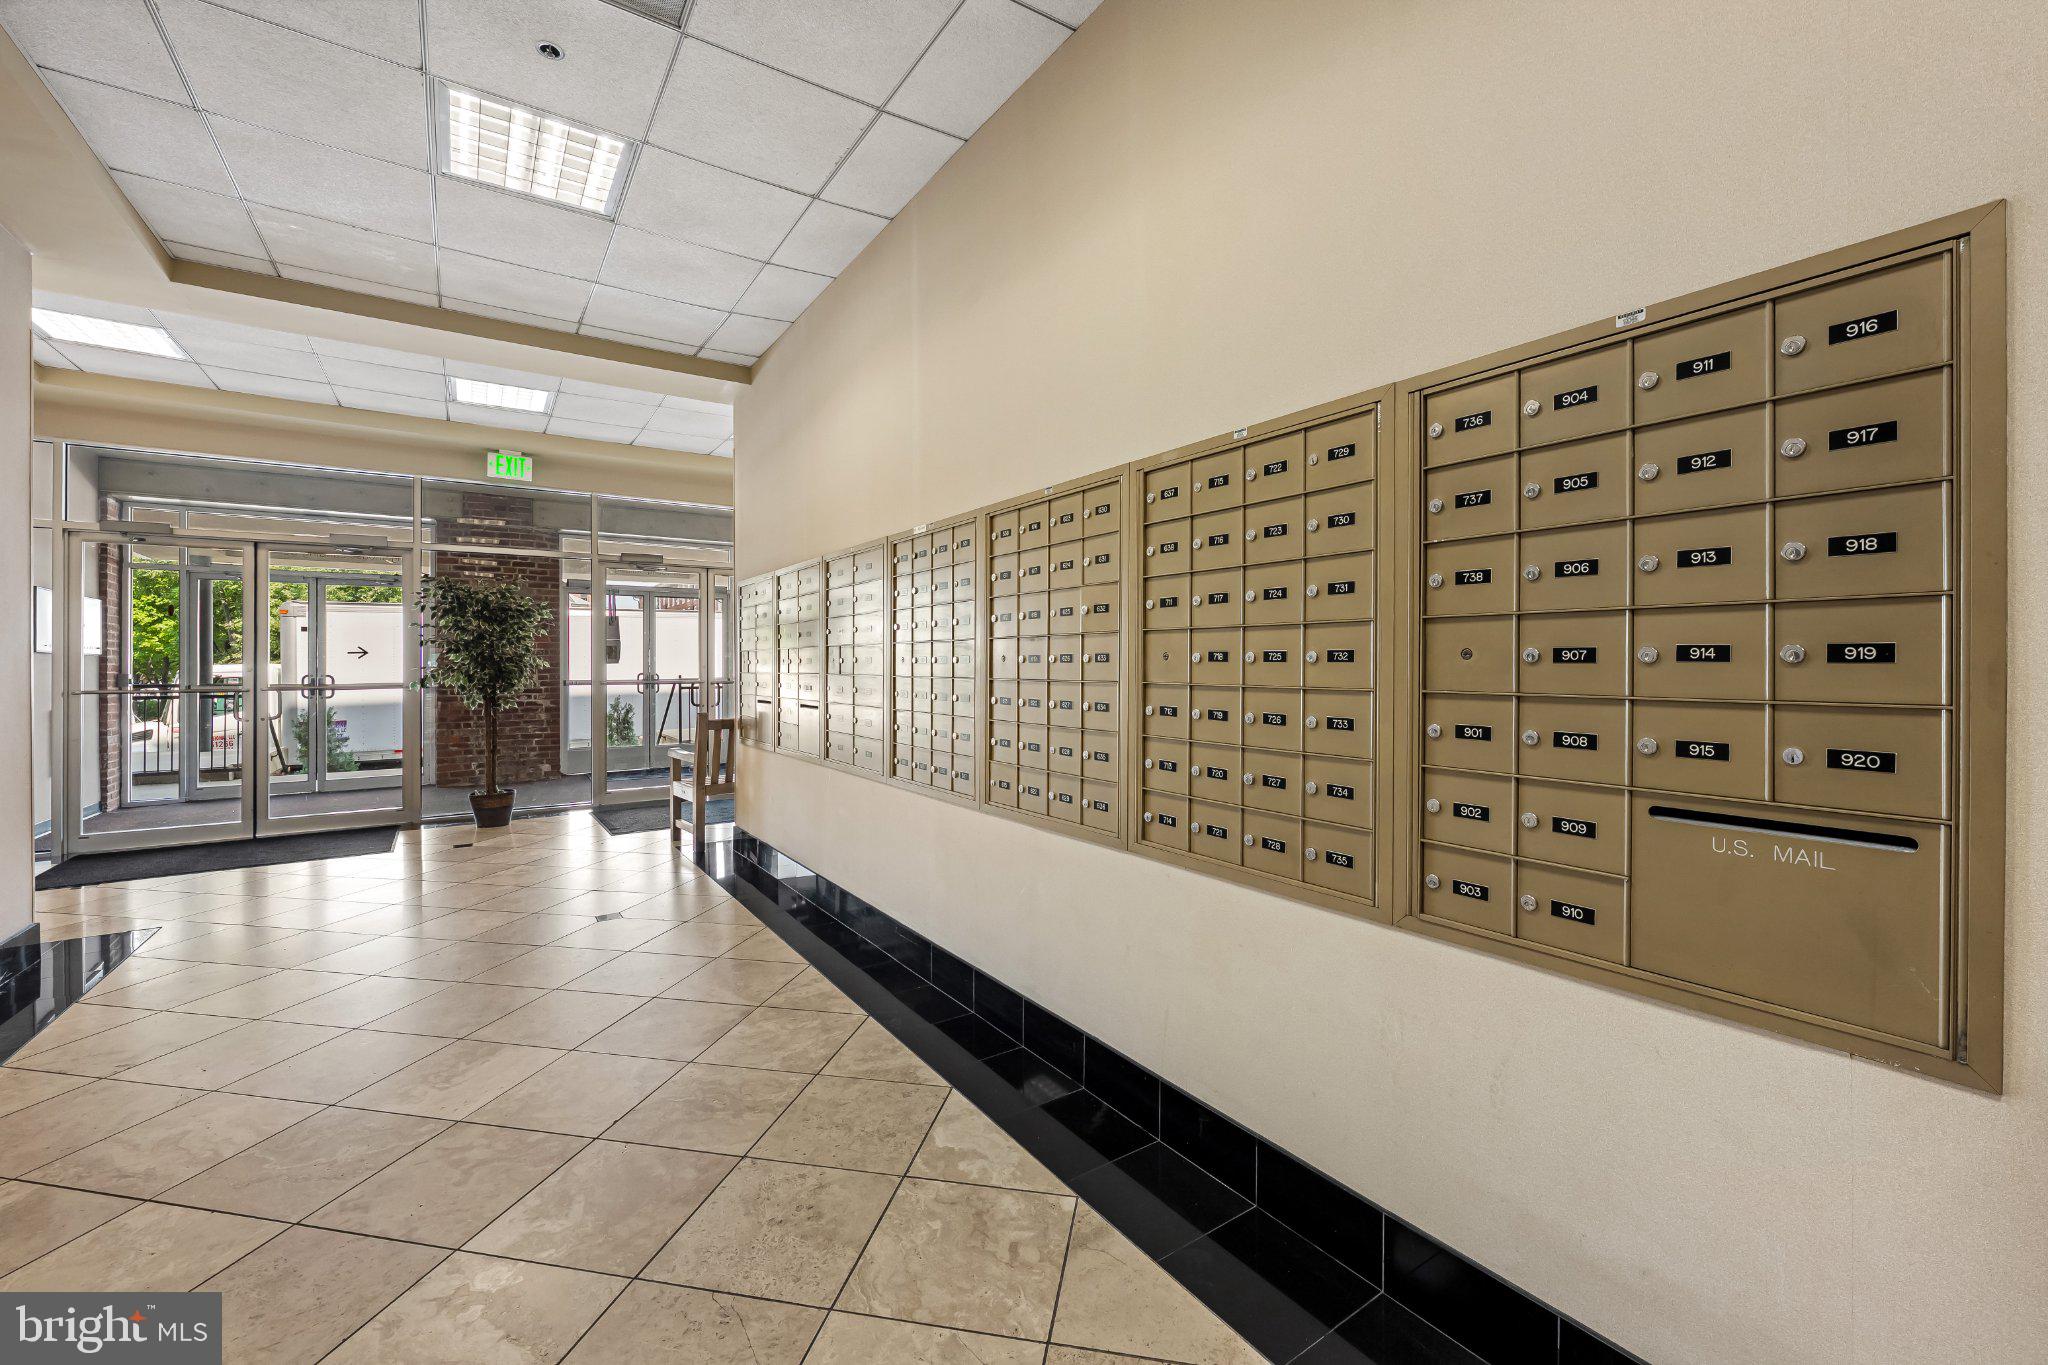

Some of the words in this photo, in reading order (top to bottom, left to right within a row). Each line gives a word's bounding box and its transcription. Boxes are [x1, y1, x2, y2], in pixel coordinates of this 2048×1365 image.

[1846, 319, 1878, 337] 916
[1693, 359, 1713, 373] 911
[1562, 391, 1588, 405] 904
[1463, 415, 1483, 428] 736
[1847, 428, 1878, 444] 917
[1334, 447, 1349, 458] 729
[496, 454, 527, 478] EXIT
[1691, 455, 1716, 469] 912
[1269, 463, 1282, 472] 722
[1214, 477, 1223, 486] 715
[1563, 476, 1588, 489] 905
[1163, 488, 1175, 498] 637
[1463, 493, 1483, 506] 737
[1333, 516, 1350, 525] 730
[1269, 526, 1282, 535] 723
[1213, 535, 1224, 545] 716
[1846, 538, 1877, 552] 918
[1691, 551, 1716, 564] 913
[1564, 563, 1589, 574] 906
[1463, 572, 1483, 582] 738
[1334, 583, 1349, 593] 731
[1213, 593, 1224, 603] 717
[1268, 589, 1283, 599] 724
[1212, 652, 1224, 661] 718
[1267, 651, 1283, 661] 725
[1332, 651, 1349, 661] 732
[1562, 650, 1587, 660] 907
[1690, 648, 1716, 659] 914
[1845, 647, 1876, 659] 919
[1163, 707, 1173, 716] 712
[1212, 710, 1224, 720] 719
[1268, 715, 1281, 724] 726
[1333, 719, 1348, 728] 733
[1464, 727, 1482, 737] 901
[1562, 735, 1587, 747] 908
[1689, 744, 1714, 756] 915
[1841, 753, 1880, 770] 920
[1212, 769, 1223, 778] 720
[1268, 777, 1281, 786] 727
[1333, 787, 1348, 797] 734
[1461, 806, 1481, 818] 902
[1162, 816, 1173, 825] 714
[1211, 827, 1223, 837] 721
[1561, 821, 1586, 834] 909
[1267, 840, 1280, 850] 728
[1712, 836, 1754, 858] U.S.
[1774, 844, 1836, 871] MAIL
[1332, 854, 1347, 865] 735
[1460, 884, 1481, 897] 903
[1562, 906, 1583, 919] 910
